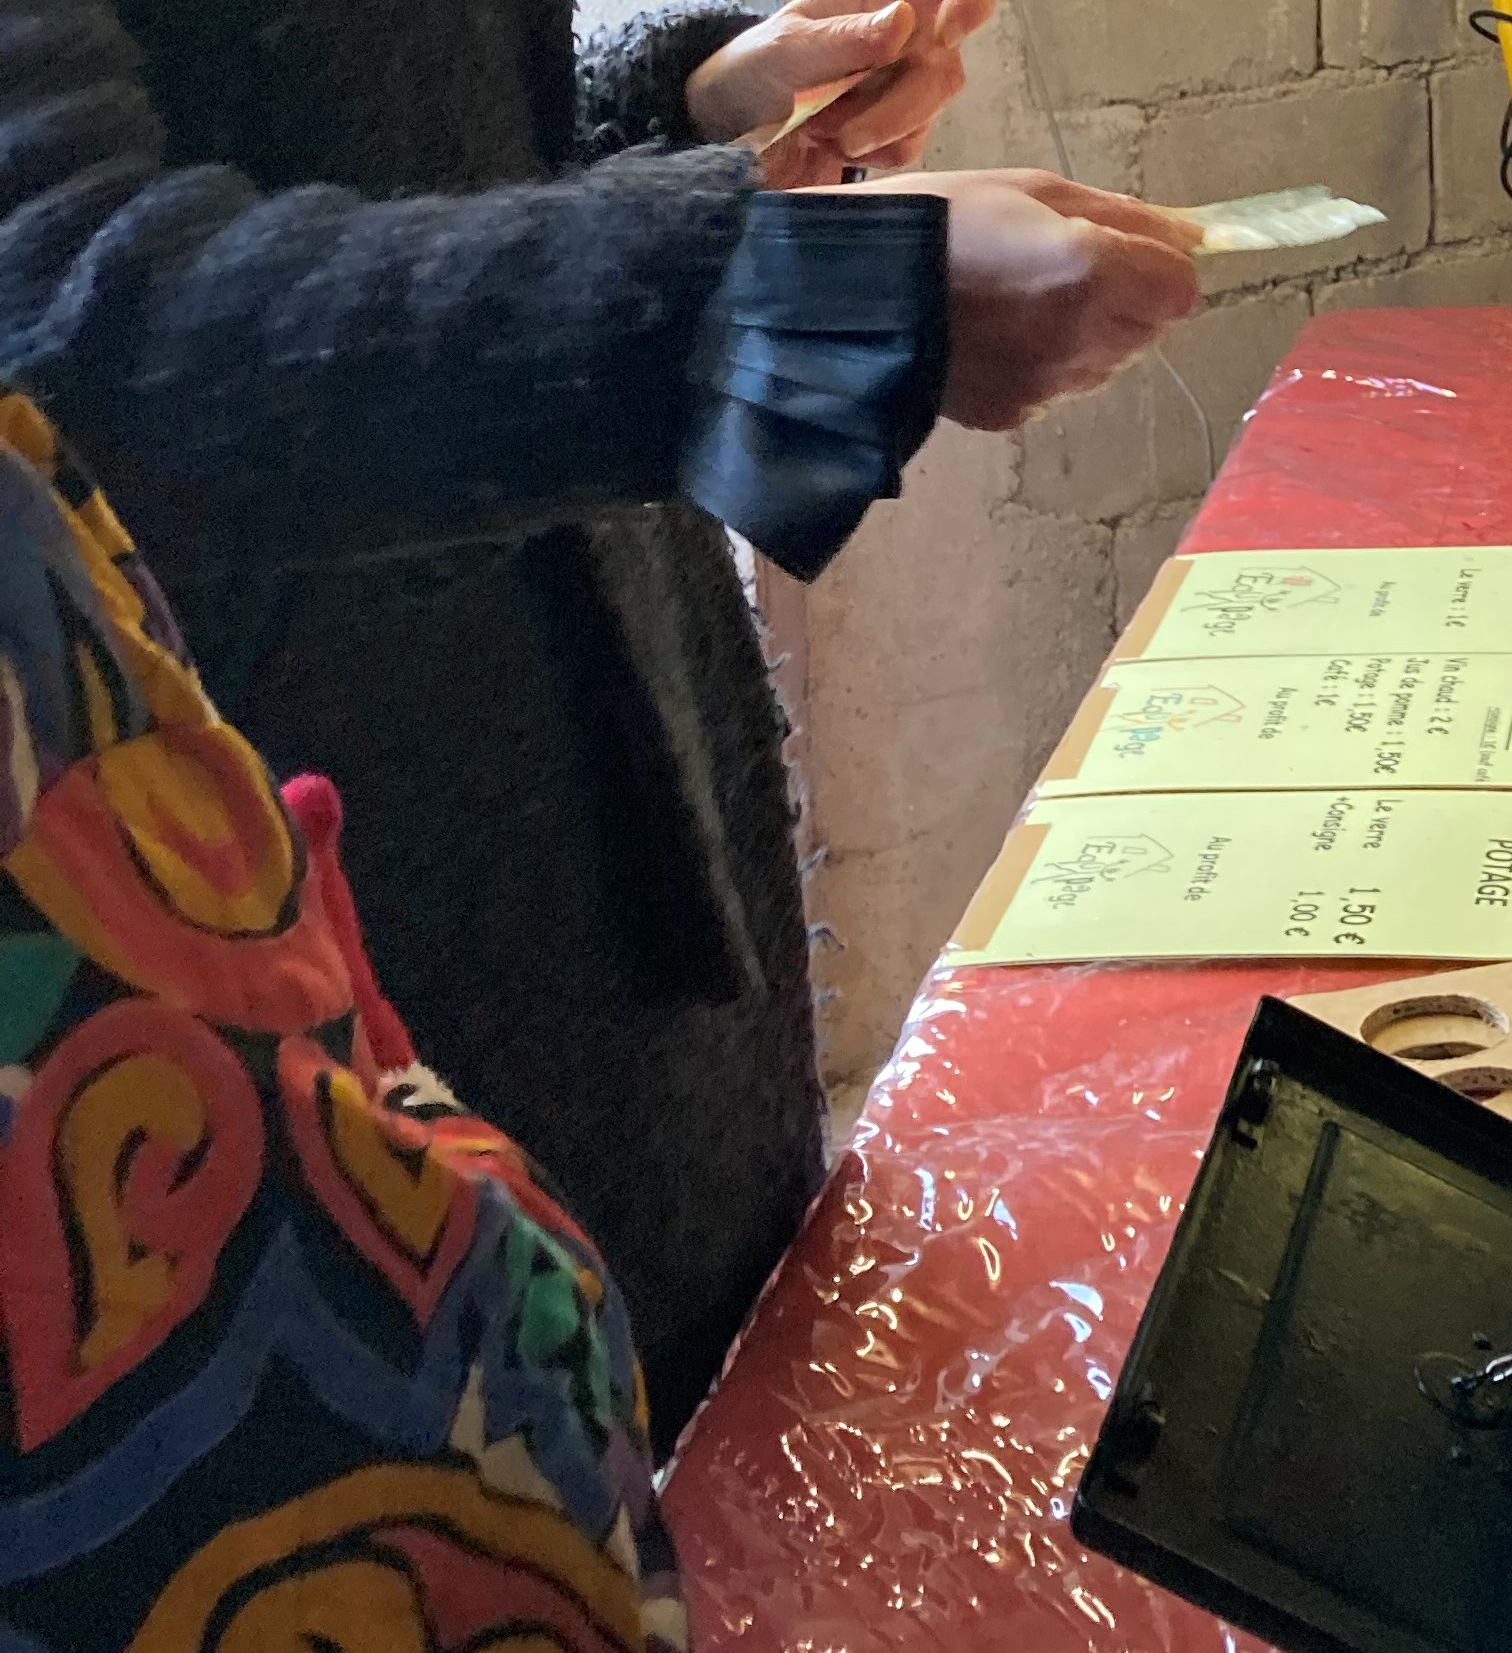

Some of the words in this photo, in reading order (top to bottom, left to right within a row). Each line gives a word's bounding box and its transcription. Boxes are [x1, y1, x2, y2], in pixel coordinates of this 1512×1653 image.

[1459, 568, 1482, 578] Le
[1450, 581, 1473, 603] verre
[1323, 659, 1353, 681] Café
[1353, 657, 1392, 689] Potage
[1404, 657, 1430, 674] Jus
[1444, 657, 1470, 672] Vin
[1399, 677, 1425, 689] de
[1434, 674, 1465, 703] chaud
[1276, 687, 1299, 699] Au
[1314, 693, 1341, 706] 1€
[1264, 700, 1288, 726] profit
[1345, 702, 1377, 732] 1,50€
[1387, 692, 1414, 726] pomme
[1258, 726, 1283, 739] de
[1427, 727, 1449, 735] €
[1374, 740, 1406, 774] 1,50€
[1375, 799, 1404, 812] Le
[1363, 817, 1391, 849] verre
[1207, 836, 1233, 850] Au
[1190, 853, 1219, 884] profit
[1184, 886, 1212, 901] de
[1290, 891, 1325, 922] 1,00
[1338, 887, 1382, 926] 1,50
[1284, 927, 1310, 937] €
[1333, 932, 1365, 945] €
